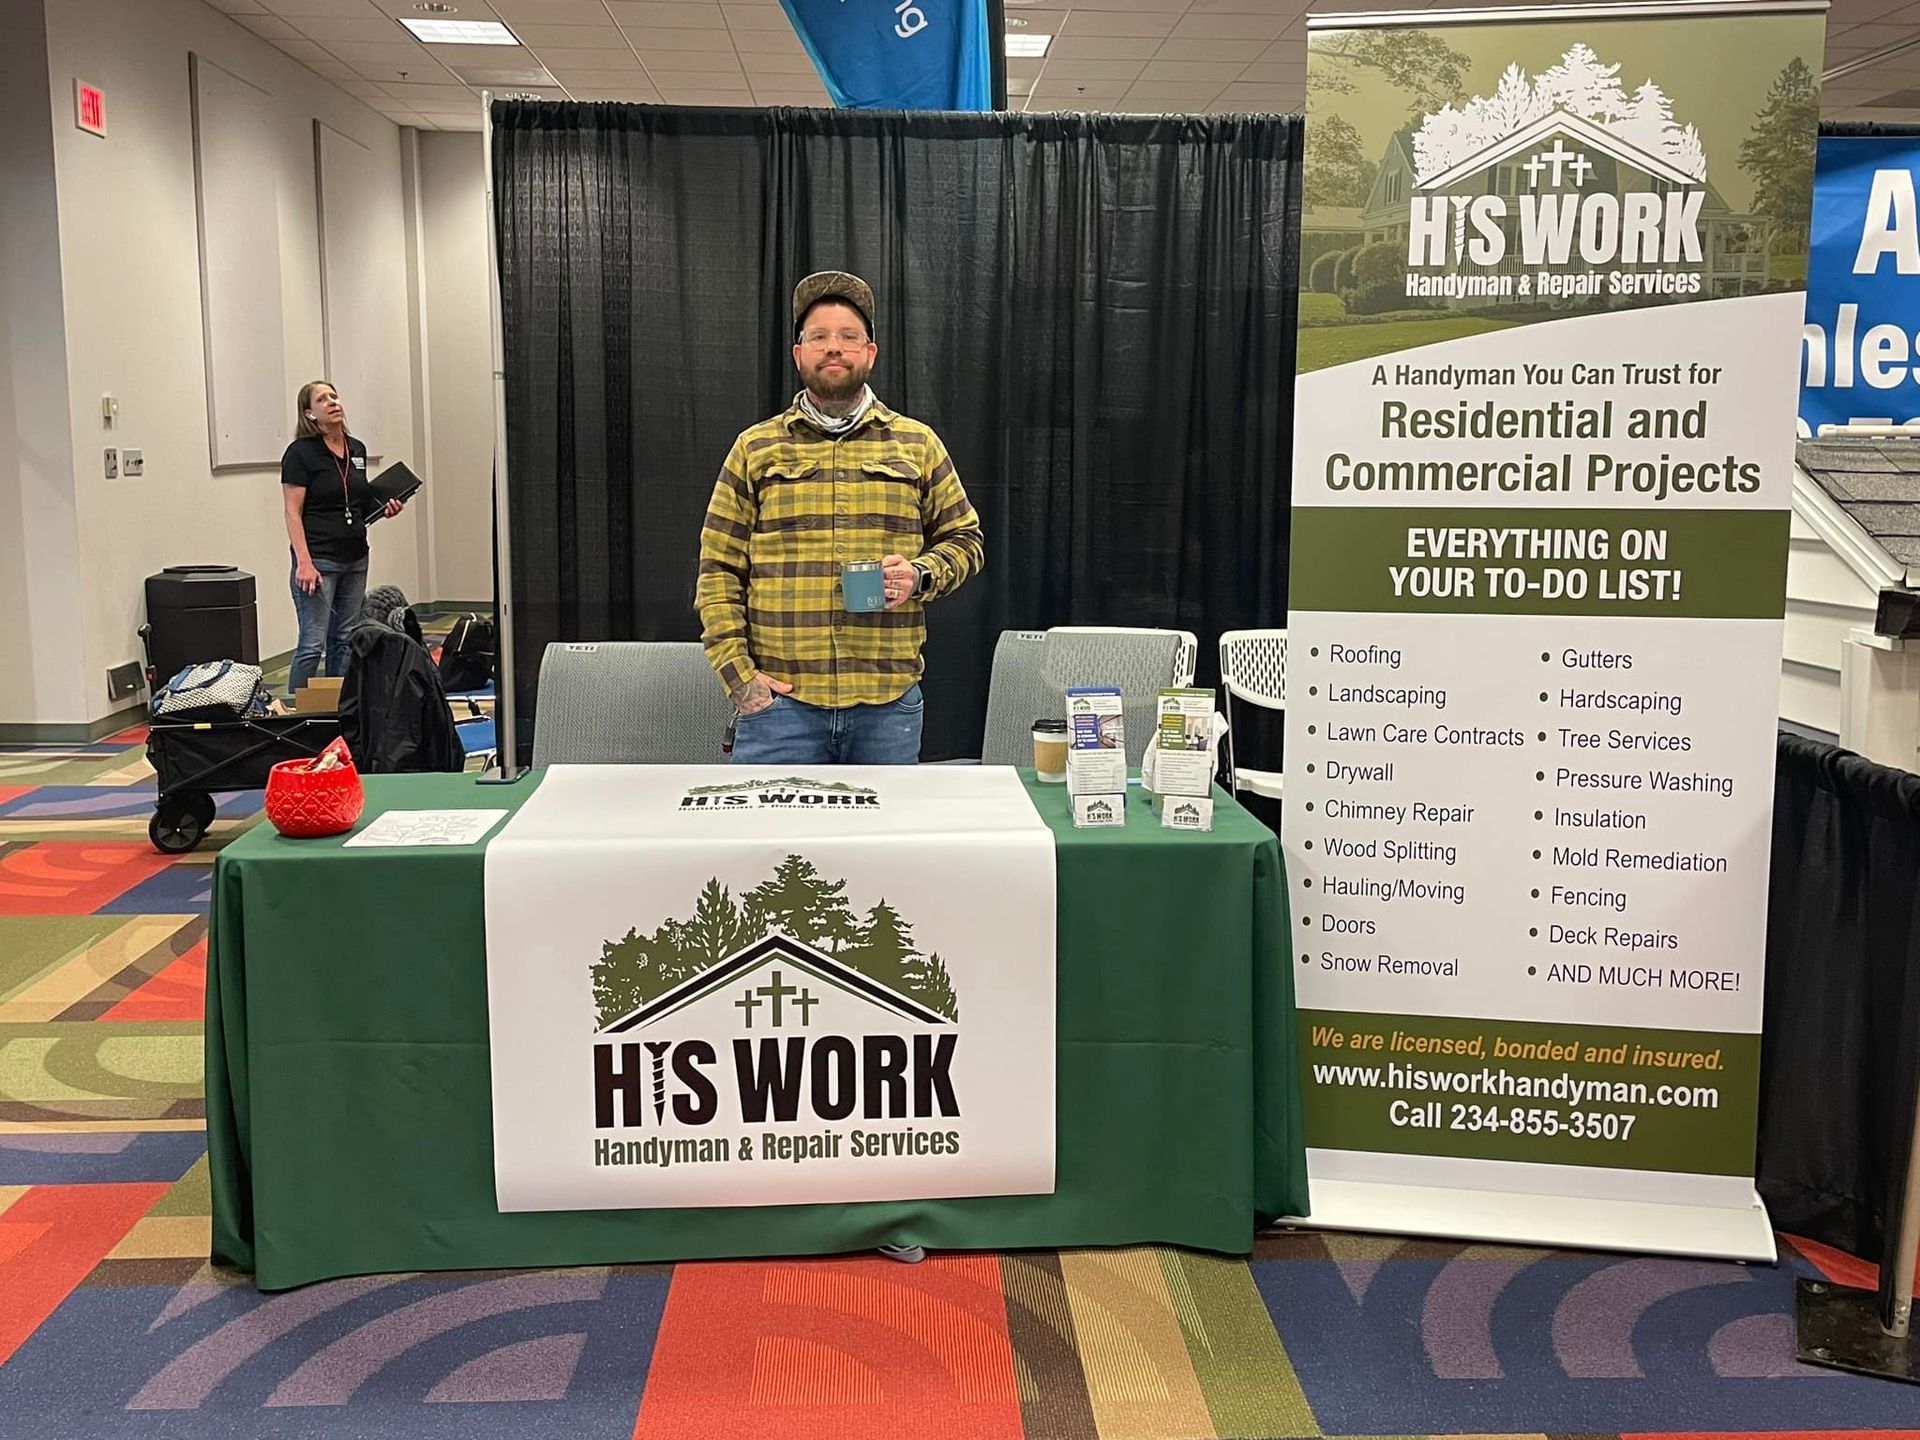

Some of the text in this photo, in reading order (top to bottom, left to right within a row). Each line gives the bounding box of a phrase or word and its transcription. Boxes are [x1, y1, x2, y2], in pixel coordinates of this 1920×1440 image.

[1408, 192, 1706, 266] HIS WORK
[1406, 270, 1700, 299] Handyman & Repair Services
[1372, 363, 1722, 390] A Handyman You Can Trust for
[1382, 400, 1706, 440] Residential and
[1326, 454, 1760, 500] Commercial Projects
[1408, 528, 1667, 560] EVERYTHING ON
[1389, 568, 1681, 600] YOUR TO-DO LIST!
[1330, 645, 1401, 669] Roofing
[1562, 648, 1632, 670] Gutters
[1329, 685, 1446, 708] Landscaping
[1559, 689, 1681, 715] Hardscaping
[1327, 723, 1524, 748] Lawn Care Contracts
[1558, 728, 1691, 752] Tree Services
[1326, 762, 1393, 786] Drywall
[1556, 769, 1733, 797] Pressure Washing
[759, 794, 880, 804] WORK
[1325, 800, 1474, 826] Chimney Repair
[1554, 809, 1645, 830] Insulation
[1324, 838, 1457, 866] Wood Splitting
[1553, 848, 1727, 873] Mold Remediation
[1323, 877, 1464, 904] Hauling/Moving
[1551, 888, 1626, 912] Fencing
[1322, 915, 1376, 935] Doors
[1549, 926, 1677, 951] Deck Repairs
[1321, 953, 1458, 977] Snow Removal
[1547, 965, 1740, 991] AND MUCH MORE!
[1312, 1026, 1724, 1070] We are licensed, bonded and insured.
[594, 1034, 960, 1128] HIS WORK
[1313, 1061, 1718, 1108] www.hisworkhandyman.com
[1390, 1101, 1635, 1141] Call 234-855-3507
[595, 1128, 960, 1166] Handyman & Repair Services
